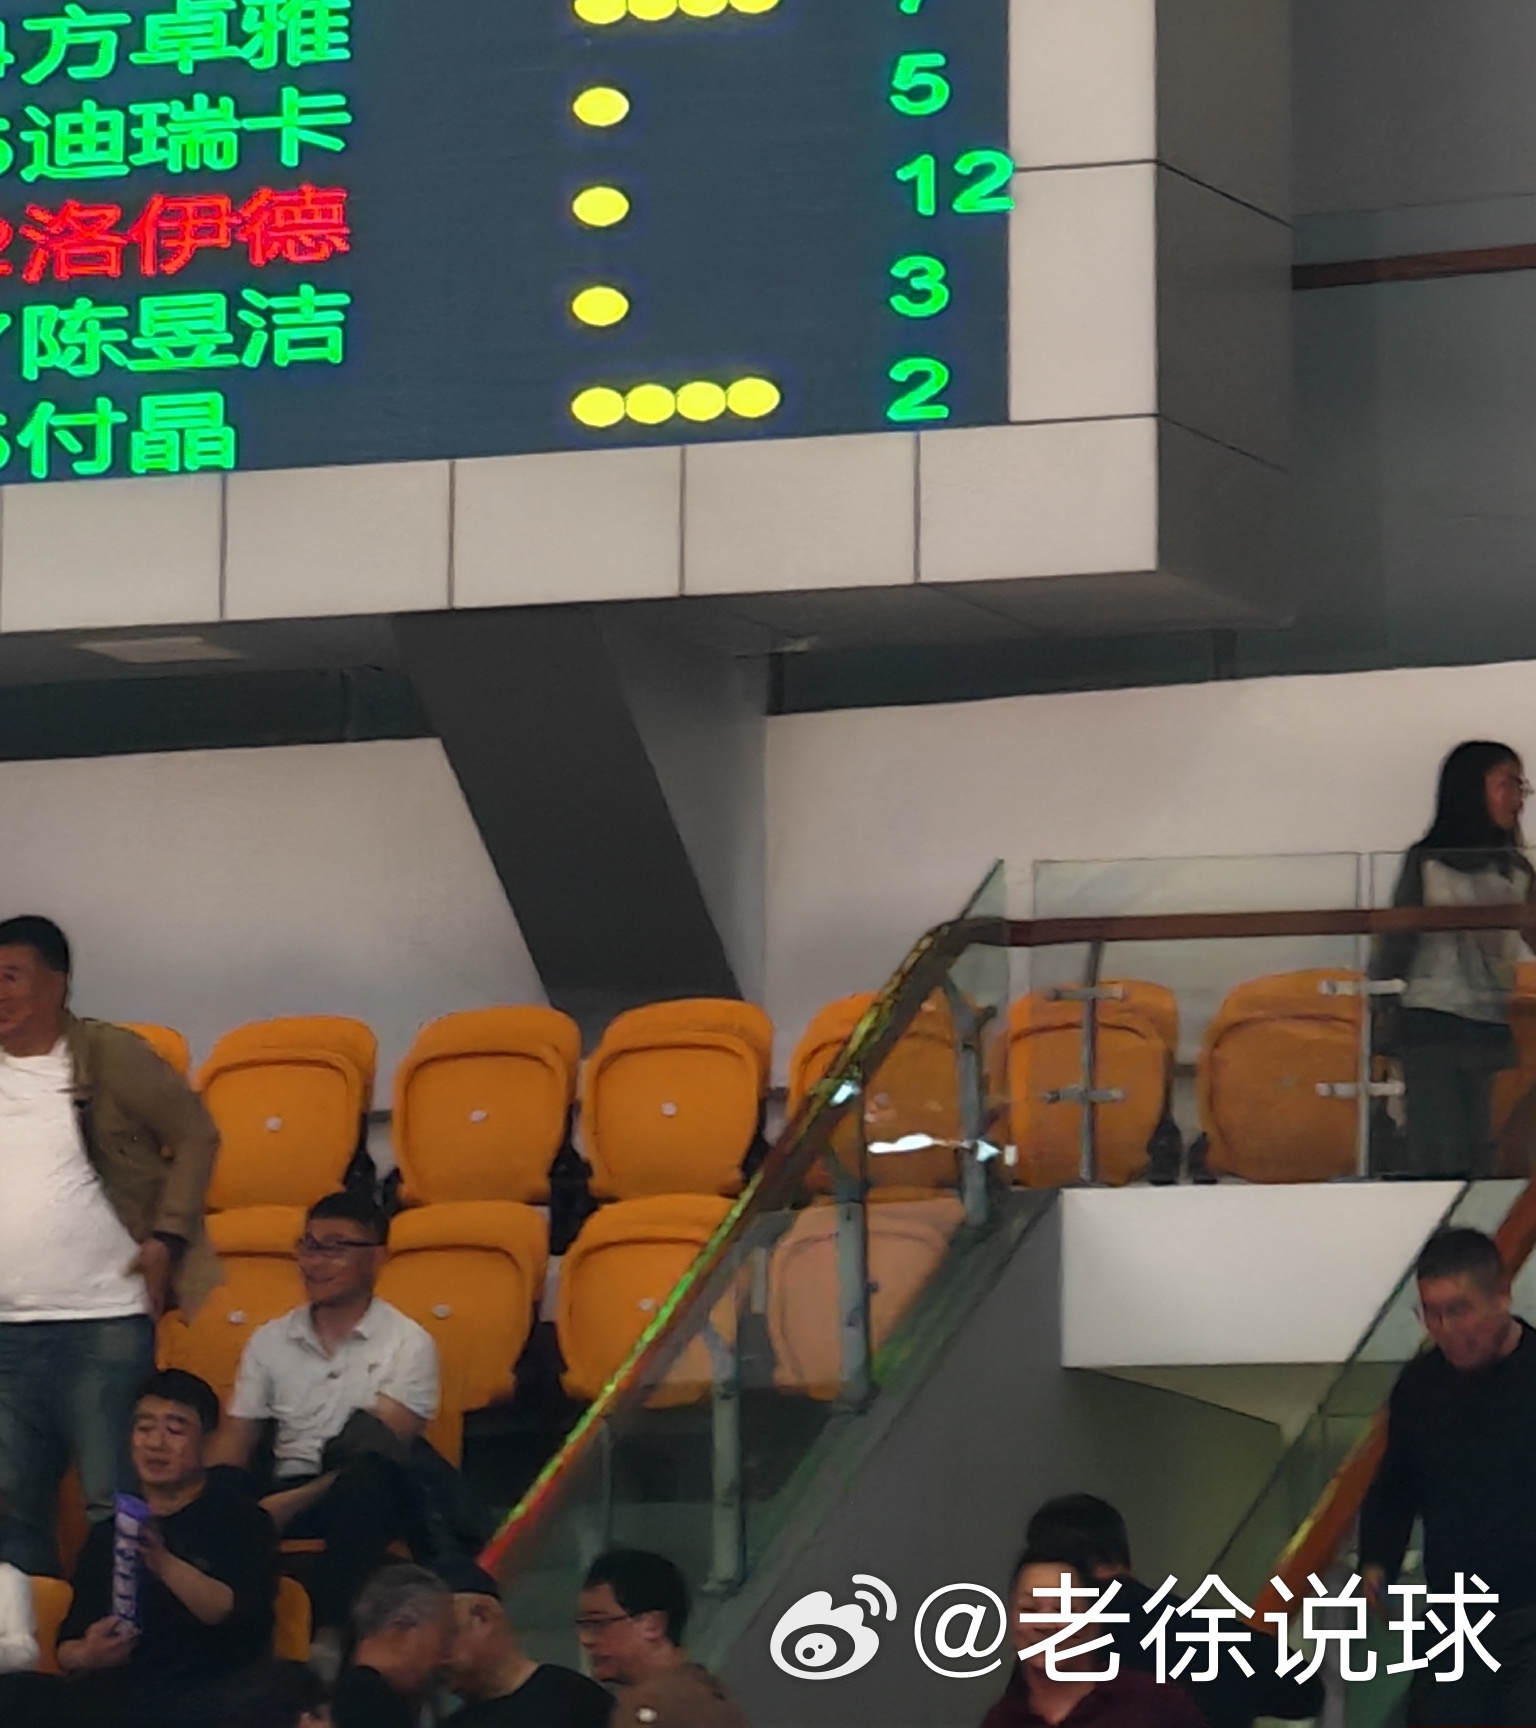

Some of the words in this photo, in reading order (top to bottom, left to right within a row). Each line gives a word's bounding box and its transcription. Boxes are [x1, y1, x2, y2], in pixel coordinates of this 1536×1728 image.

[888, 51, 951, 117] 5
[894, 149, 1016, 217] 12
[888, 254, 950, 318] 3
[885, 356, 950, 423] 2
